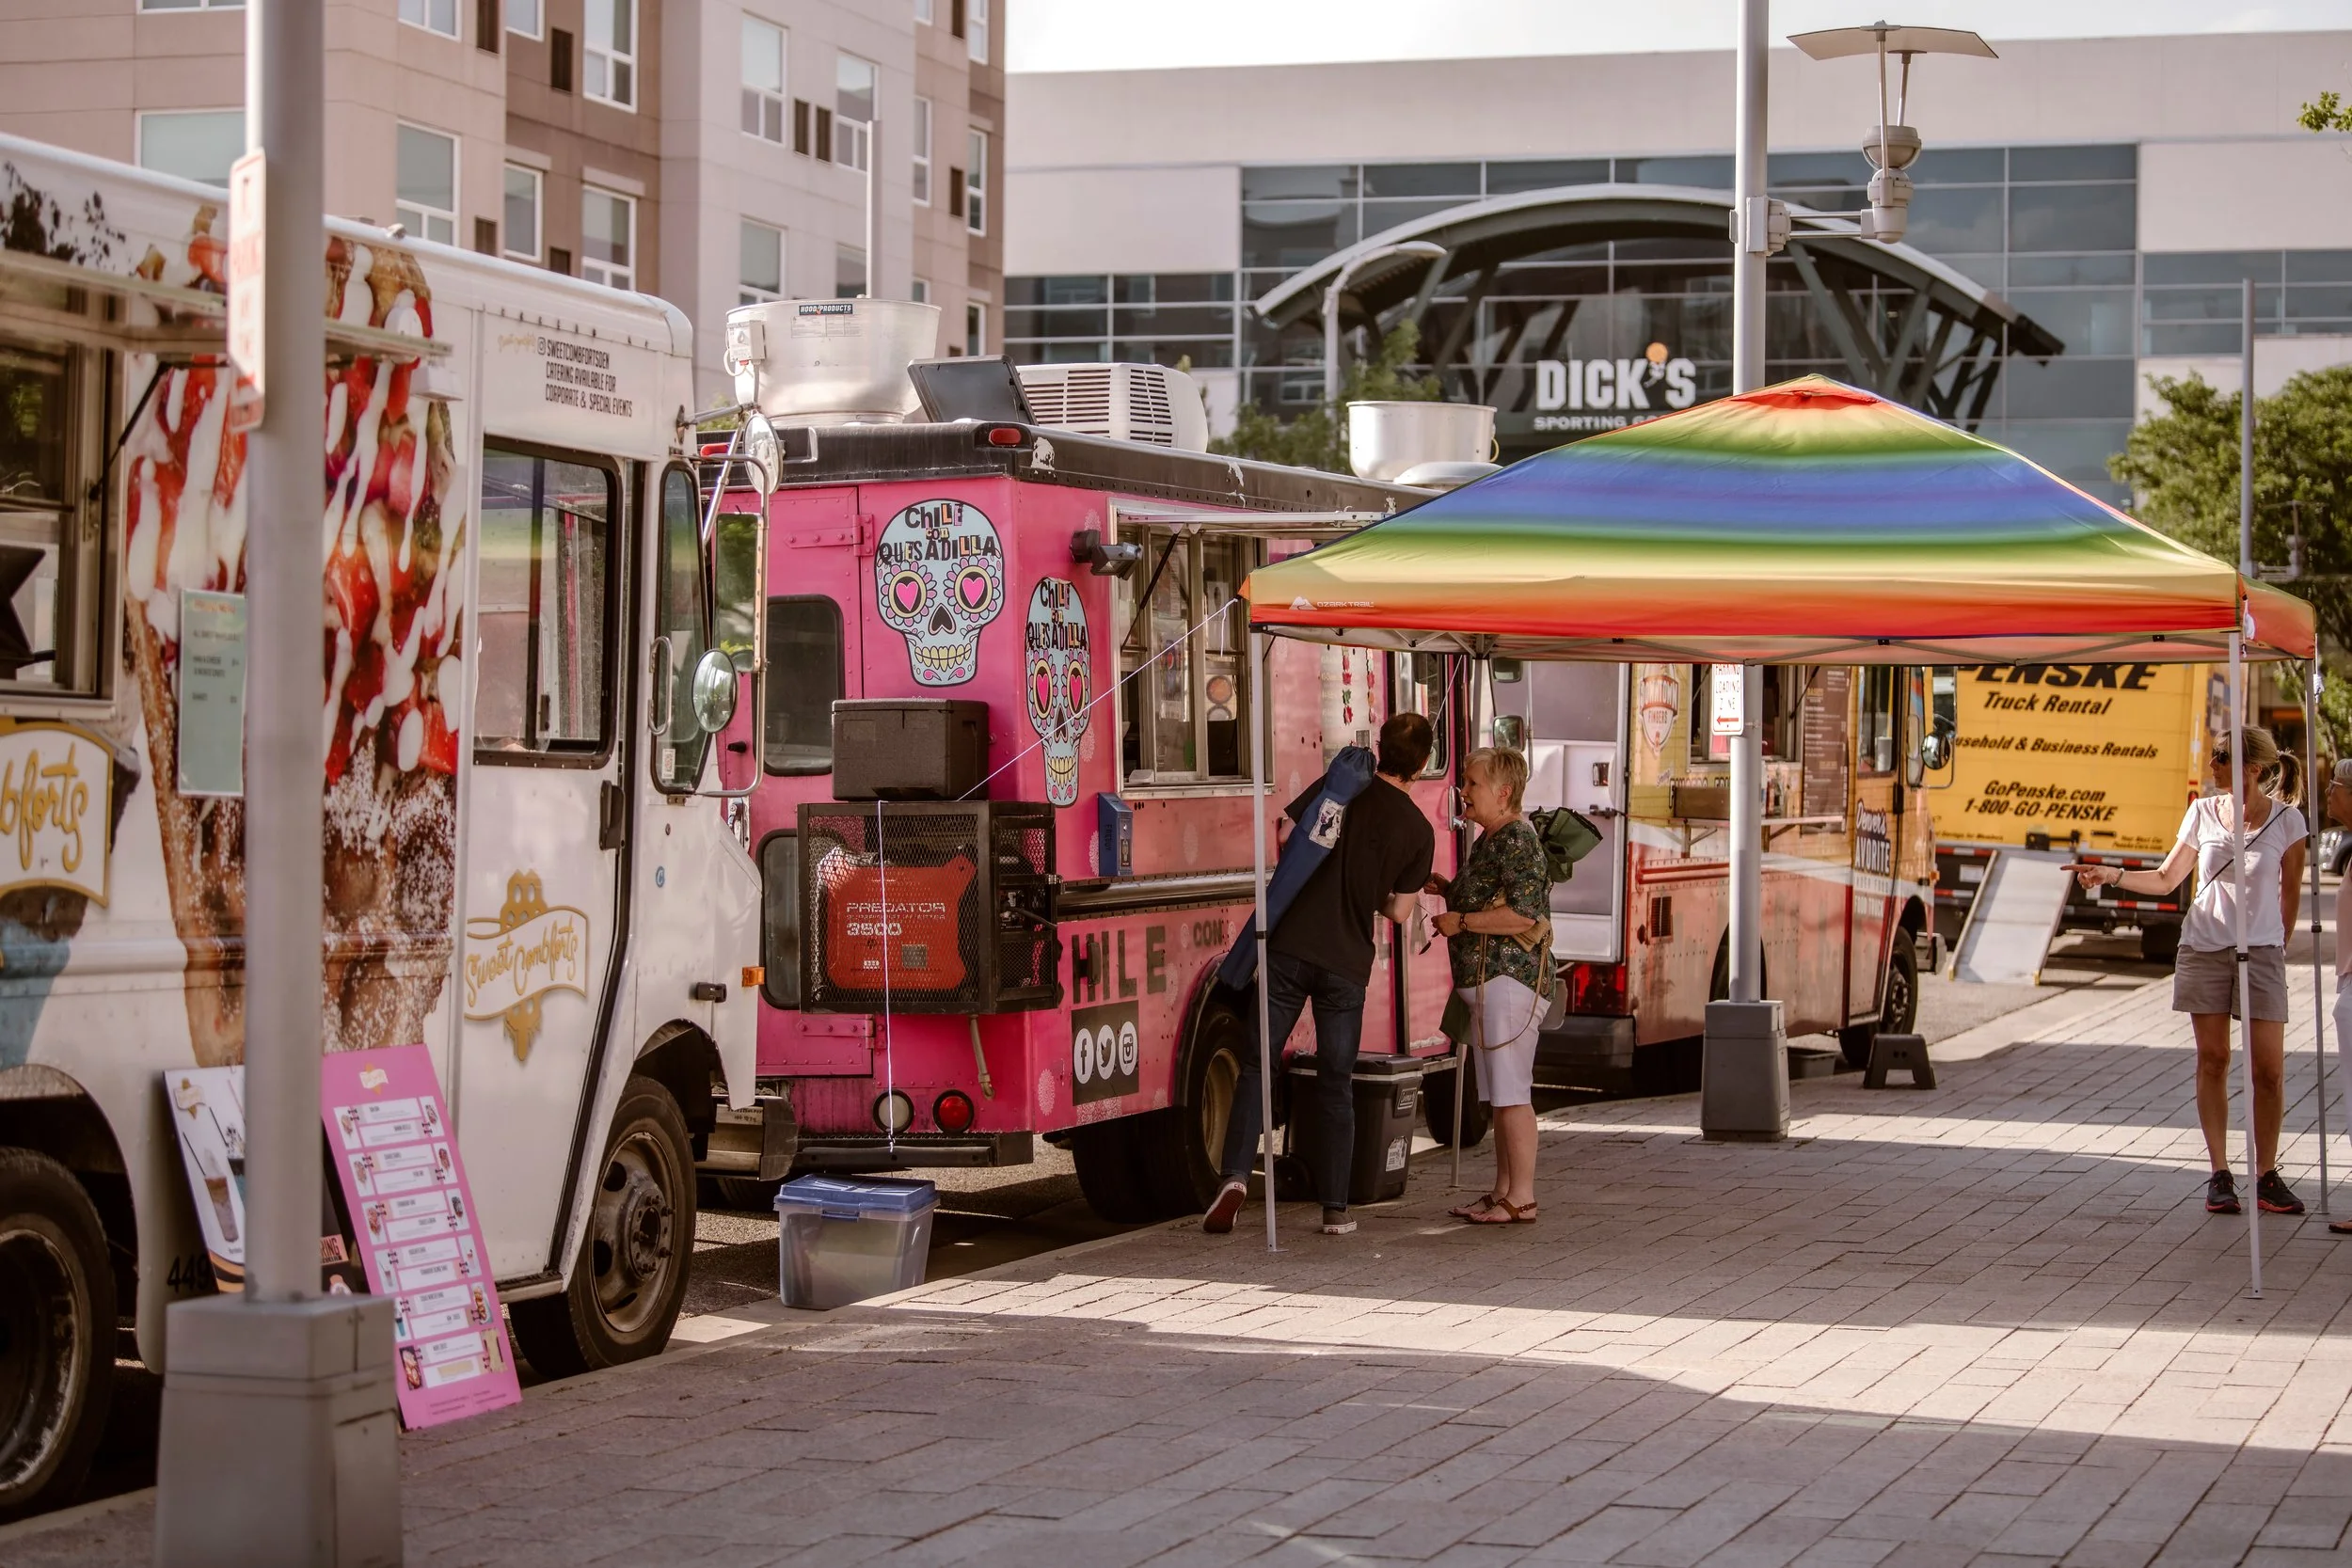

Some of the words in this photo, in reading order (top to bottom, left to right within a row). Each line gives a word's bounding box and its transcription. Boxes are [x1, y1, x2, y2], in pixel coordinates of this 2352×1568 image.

[547, 339, 610, 370] SWEETCOMBFORTSDEN
[546, 361, 573, 384] CATERING
[575, 368, 604, 390] AVAILABLE
[605, 374, 616, 392] FOR
[1536, 357, 1696, 410] DICK'S
[546, 384, 579, 407] CORPORATE
[589, 392, 612, 414] SPECIAL
[612, 398, 632, 418] EVENTS
[1534, 416, 1628, 431] SPORTING
[879, 534, 996, 565] QUESADILLA
[1027, 622, 1087, 651] QUESADILLA
[1958, 664, 2162, 690] ENSKE
[1720, 697, 1736, 710] ZNE
[1983, 691, 2039, 712] Truck
[2042, 694, 2113, 715] Rental
[1955, 735, 2014, 751] usehold
[2015, 736, 2027, 751] &
[2031, 737, 2099, 754] Business
[2101, 742, 2158, 759] Rentals
[1984, 780, 2106, 802] GoPenske.com
[1963, 798, 2118, 822] 1-800-GO-PENSKE
[847, 902, 946, 913] PREDATOR
[466, 934, 514, 1008] Sweet
[513, 915, 579, 996] Combforts
[1057, 926, 1167, 1006] HILE
[1193, 918, 1223, 948] CON
